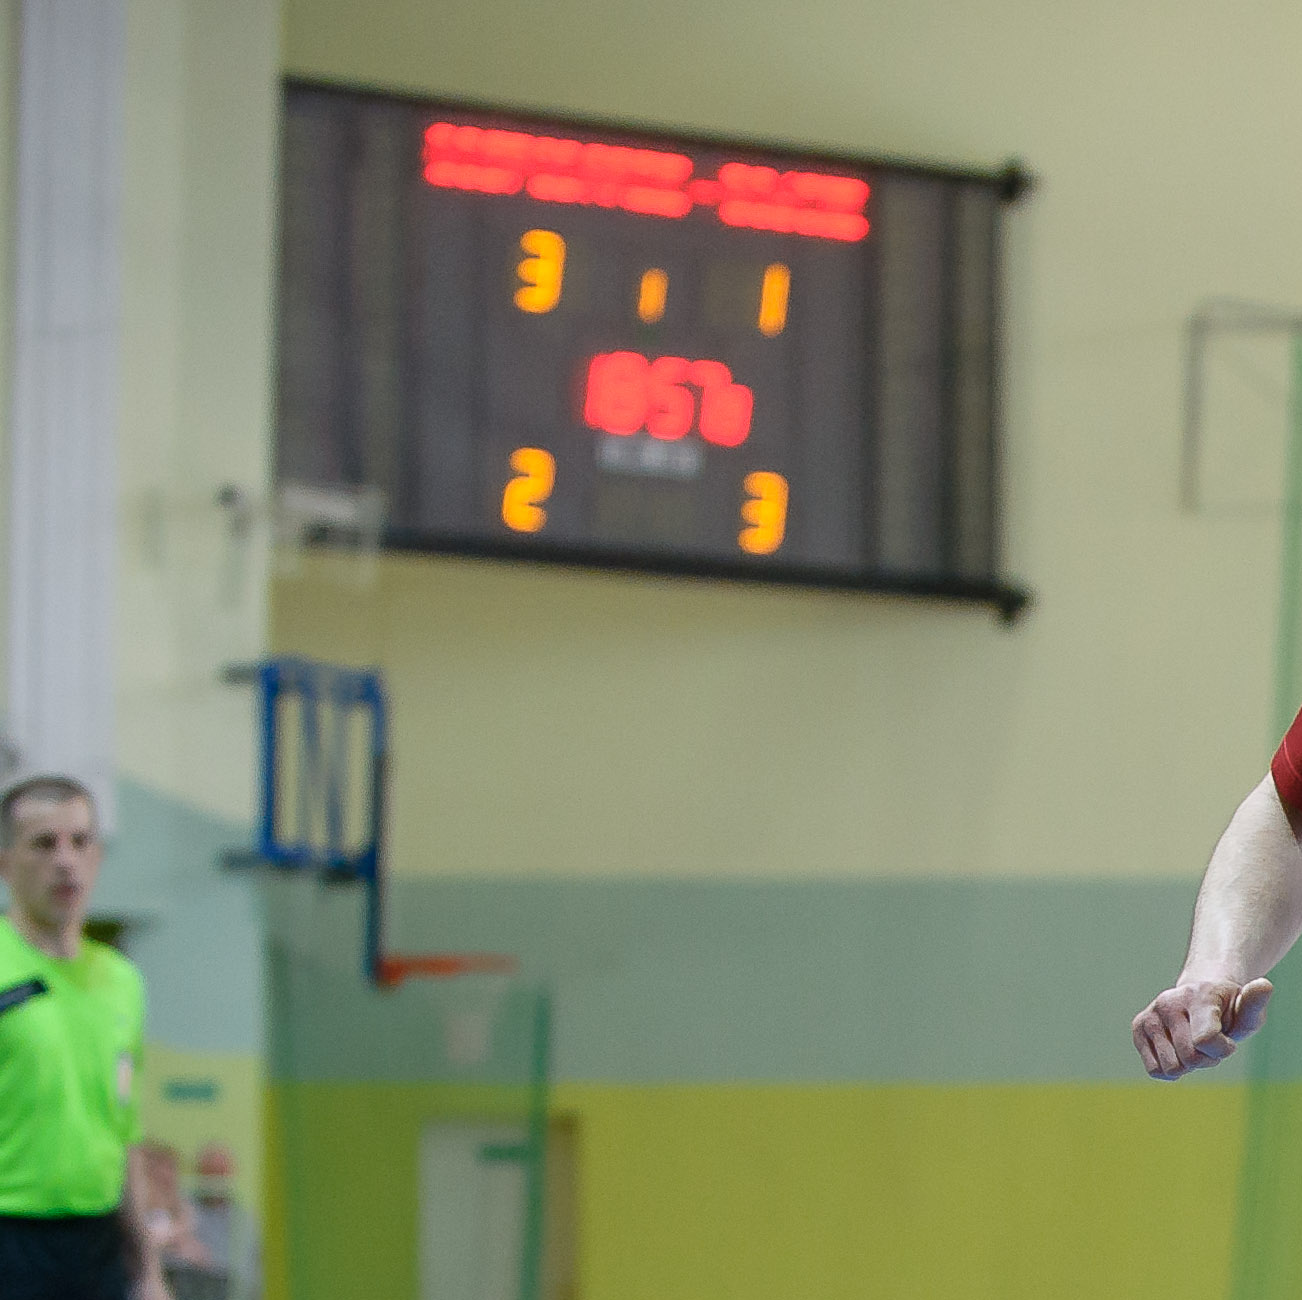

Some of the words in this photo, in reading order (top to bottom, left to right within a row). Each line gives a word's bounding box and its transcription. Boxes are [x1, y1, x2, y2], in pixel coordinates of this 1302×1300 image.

[514, 228, 567, 314] 3
[637, 267, 669, 324] 1
[759, 263, 791, 338] 1
[503, 447, 556, 533] 2
[738, 470, 790, 556] 3
